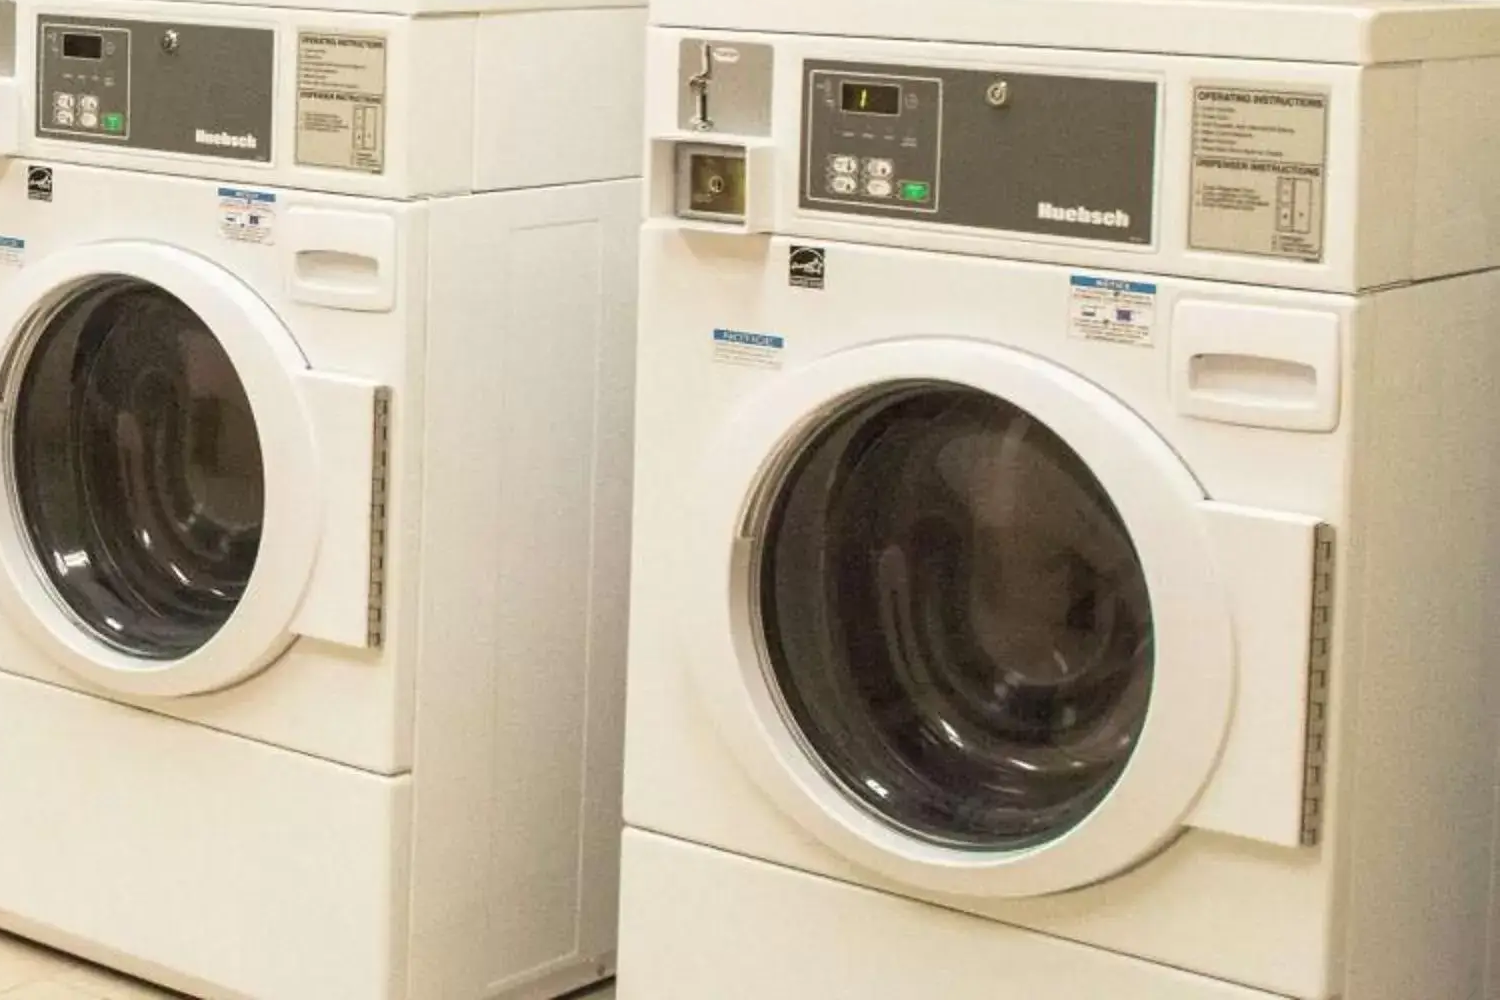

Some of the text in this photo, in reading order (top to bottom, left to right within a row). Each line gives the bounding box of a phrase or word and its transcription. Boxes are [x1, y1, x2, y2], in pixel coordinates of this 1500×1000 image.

[1197, 91, 1323, 108] OPERATING INSTRUCTIONS
[195, 129, 257, 148] Huebsch
[1038, 201, 1130, 228] Huebsch
